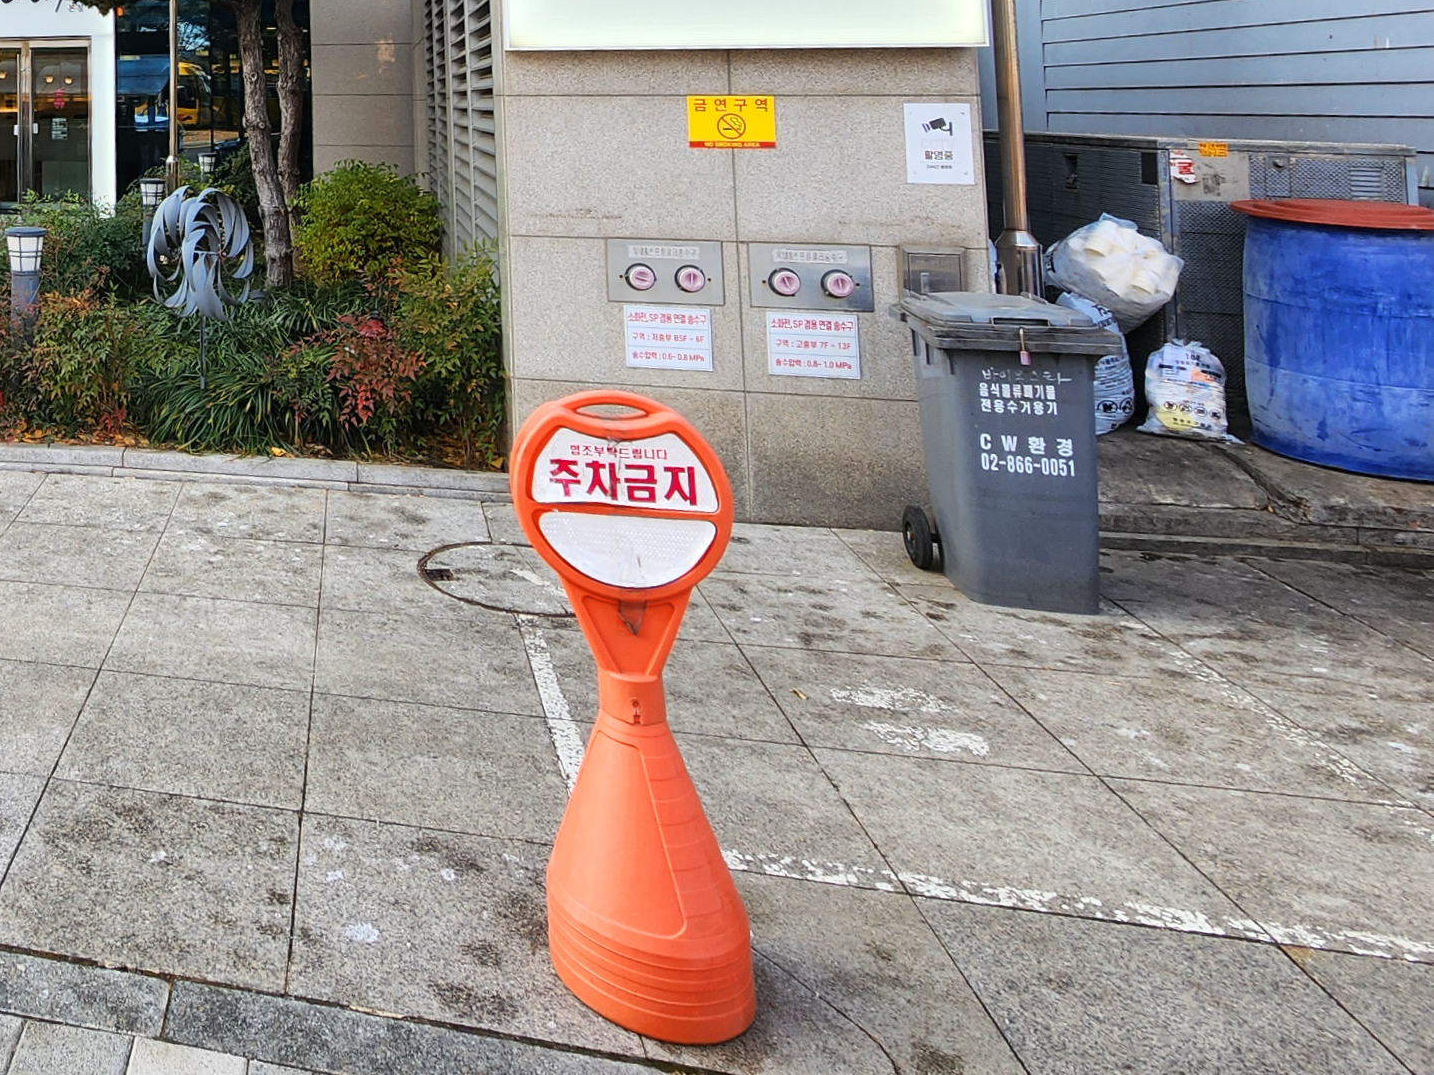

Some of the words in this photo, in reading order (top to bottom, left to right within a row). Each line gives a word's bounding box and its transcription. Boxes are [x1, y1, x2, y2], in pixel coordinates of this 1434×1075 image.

[921, 138, 955, 150] CCTV
[925, 150, 953, 160] 촬영중
[649, 314, 659, 322] SP
[793, 320, 803, 328] SP
[632, 332, 645, 340] 구역
[775, 339, 789, 347] 구역
[837, 342, 851, 350] 13F
[979, 383, 1056, 400] 음식물류폐기물
[980, 399, 1058, 415] 전용수거용기
[981, 453, 1075, 477] 02-866-0051
[549, 458, 698, 506] 주차금지
